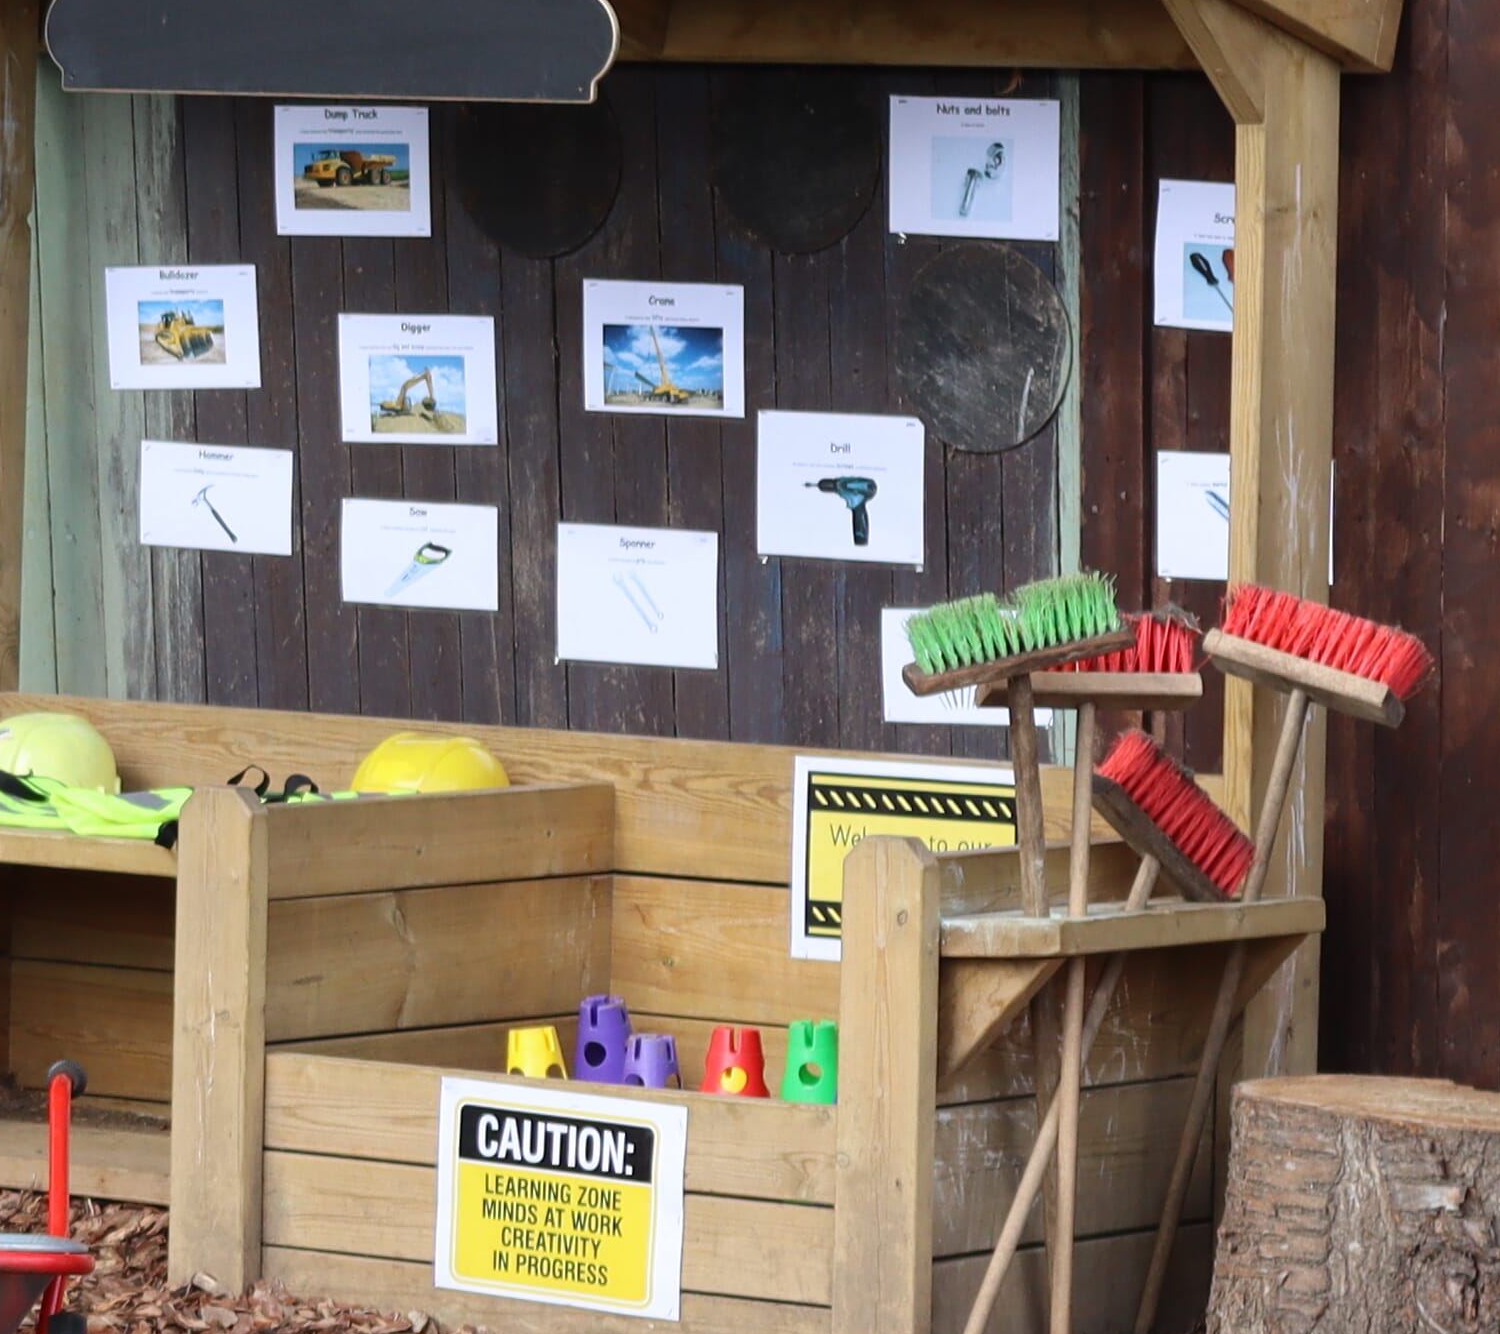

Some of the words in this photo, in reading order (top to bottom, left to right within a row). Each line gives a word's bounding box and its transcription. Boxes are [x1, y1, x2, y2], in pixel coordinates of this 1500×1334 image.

[324, 109, 348, 121] Dump
[352, 109, 378, 119] Truck
[936, 103, 959, 114] Nuts
[964, 105, 981, 115] and
[986, 105, 1010, 116] bolts
[160, 270, 198, 280] Bulldozer
[648, 295, 674, 305] Crane
[401, 322, 430, 334] Digger
[830, 443, 850, 453] Drill
[199, 450, 234, 461] Hammer
[620, 538, 655, 549] Spanner
[929, 836, 949, 852] to
[477, 1113, 635, 1176] CAUTION:
[485, 1173, 571, 1204] LEARNING
[577, 1186, 622, 1211] ZONE
[482, 1198, 538, 1225] MINDS
[544, 1207, 565, 1228] AT
[571, 1210, 623, 1237] WORK
[501, 1226, 601, 1259] CREATIVITY
[493, 1250, 509, 1271] IN
[516, 1254, 608, 1286] PROGRESS
